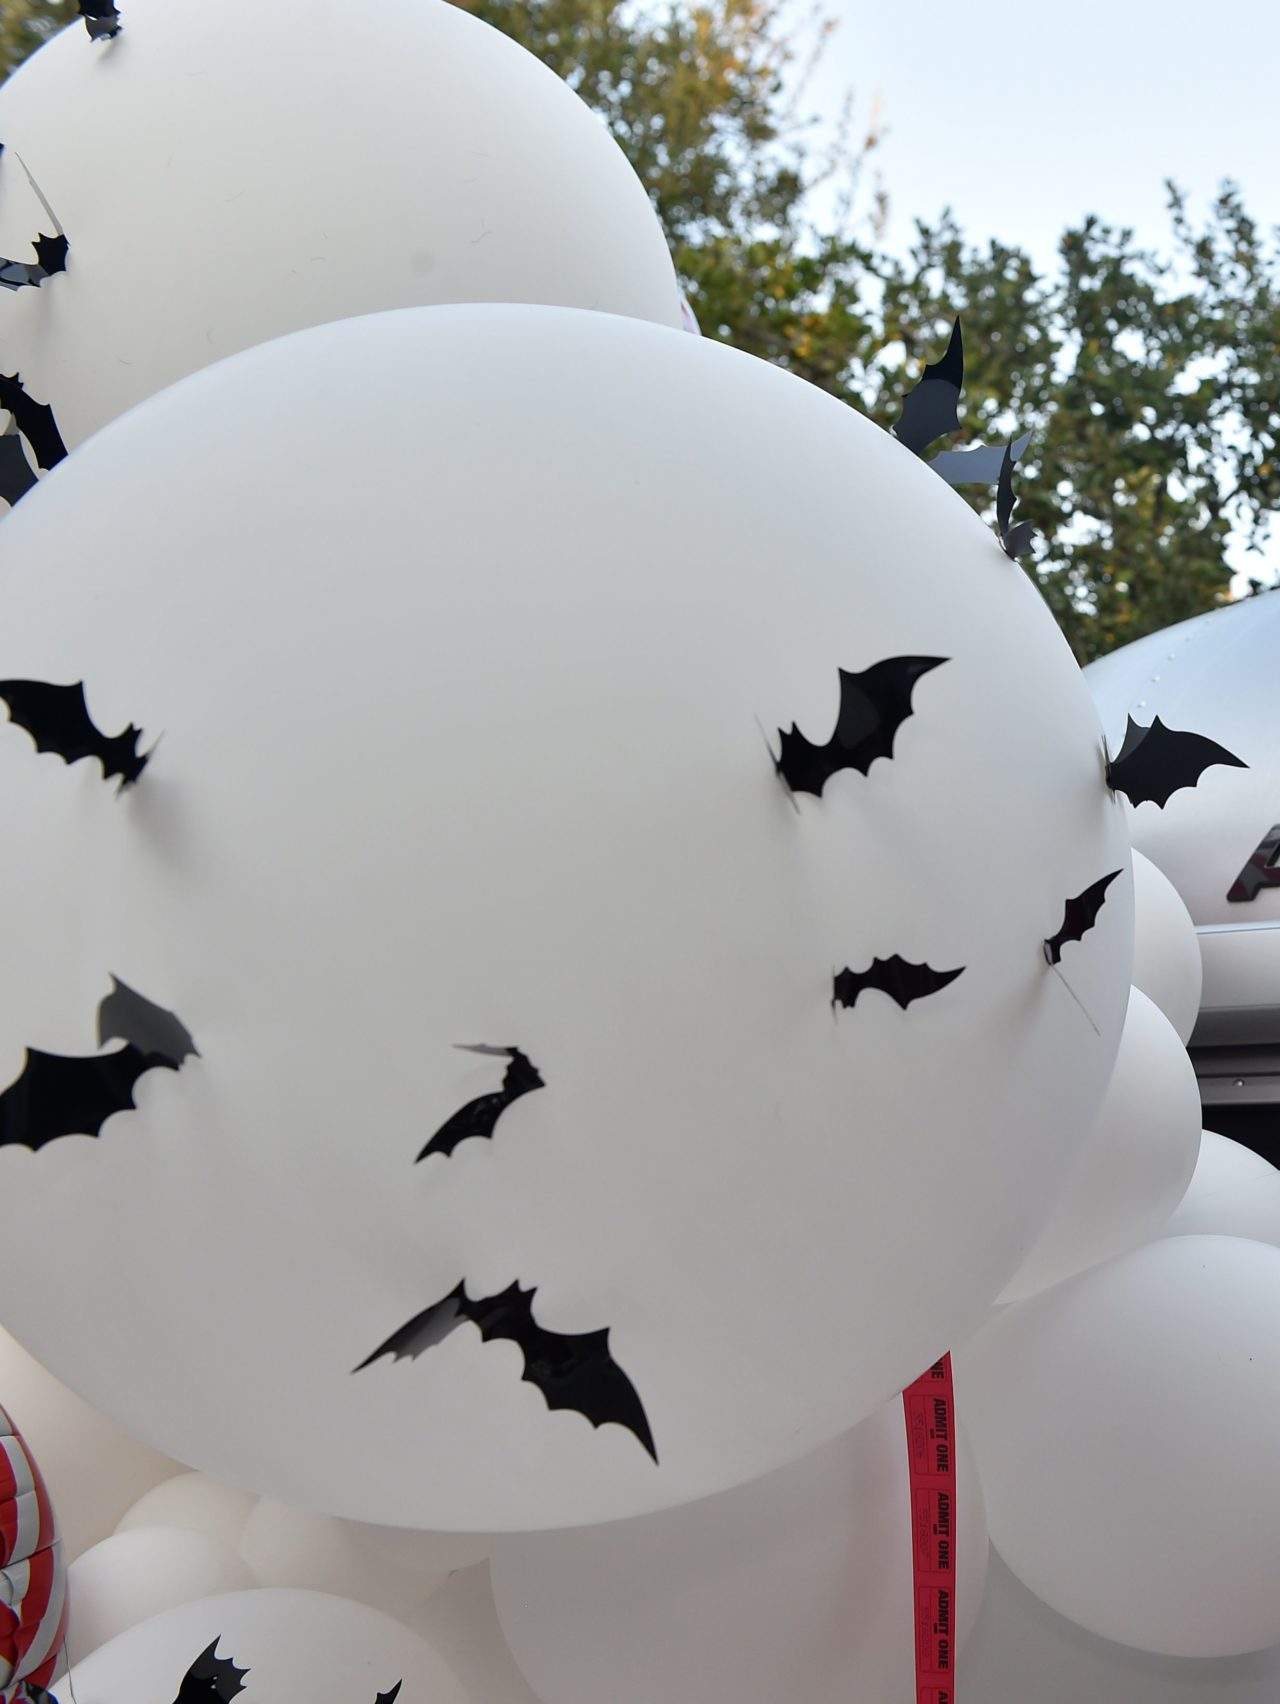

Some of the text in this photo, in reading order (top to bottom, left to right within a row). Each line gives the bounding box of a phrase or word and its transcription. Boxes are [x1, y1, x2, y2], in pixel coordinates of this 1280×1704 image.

[931, 1361, 944, 1379] NE
[934, 1398, 949, 1472] ADMIT ONE
[938, 1492, 950, 1569] ADMIT ONE
[938, 1589, 949, 1669] ADMIT ONE
